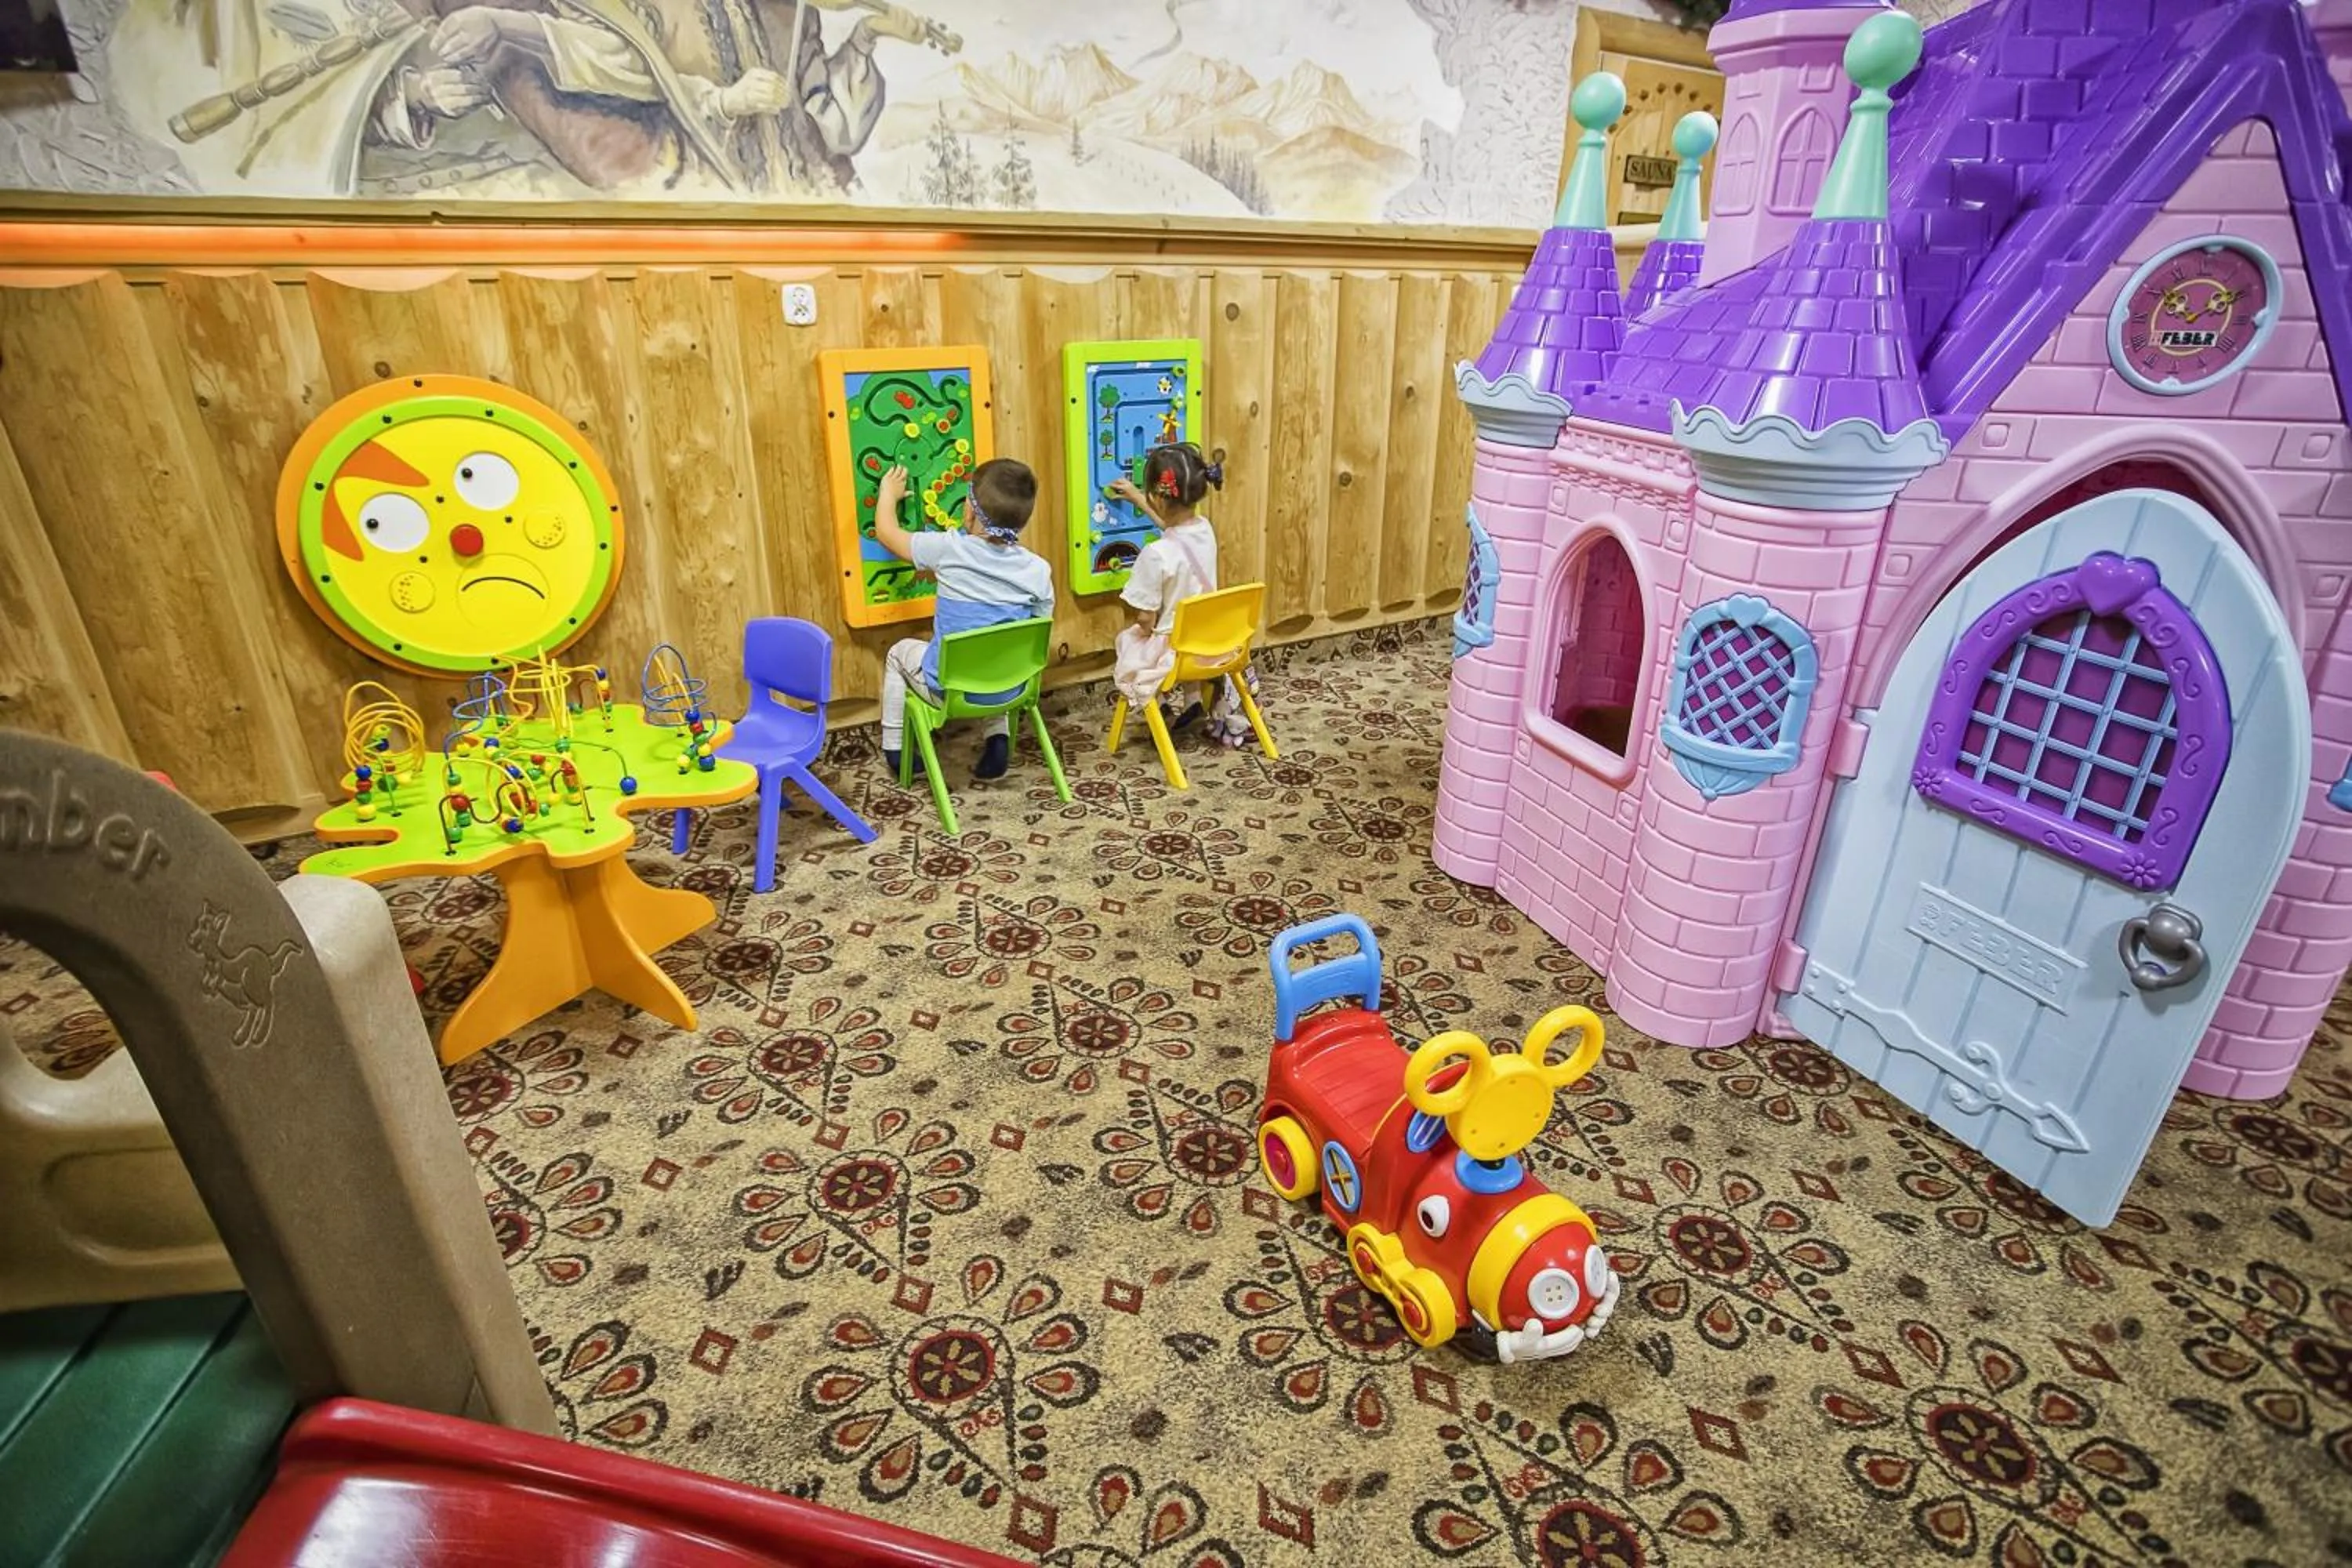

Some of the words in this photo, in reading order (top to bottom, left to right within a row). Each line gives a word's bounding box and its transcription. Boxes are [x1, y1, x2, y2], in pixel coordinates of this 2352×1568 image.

[1630, 160, 1672, 180] SAUNA
[2161, 332, 2216, 346] FEBER
[1939, 910, 2064, 997] FEBER
